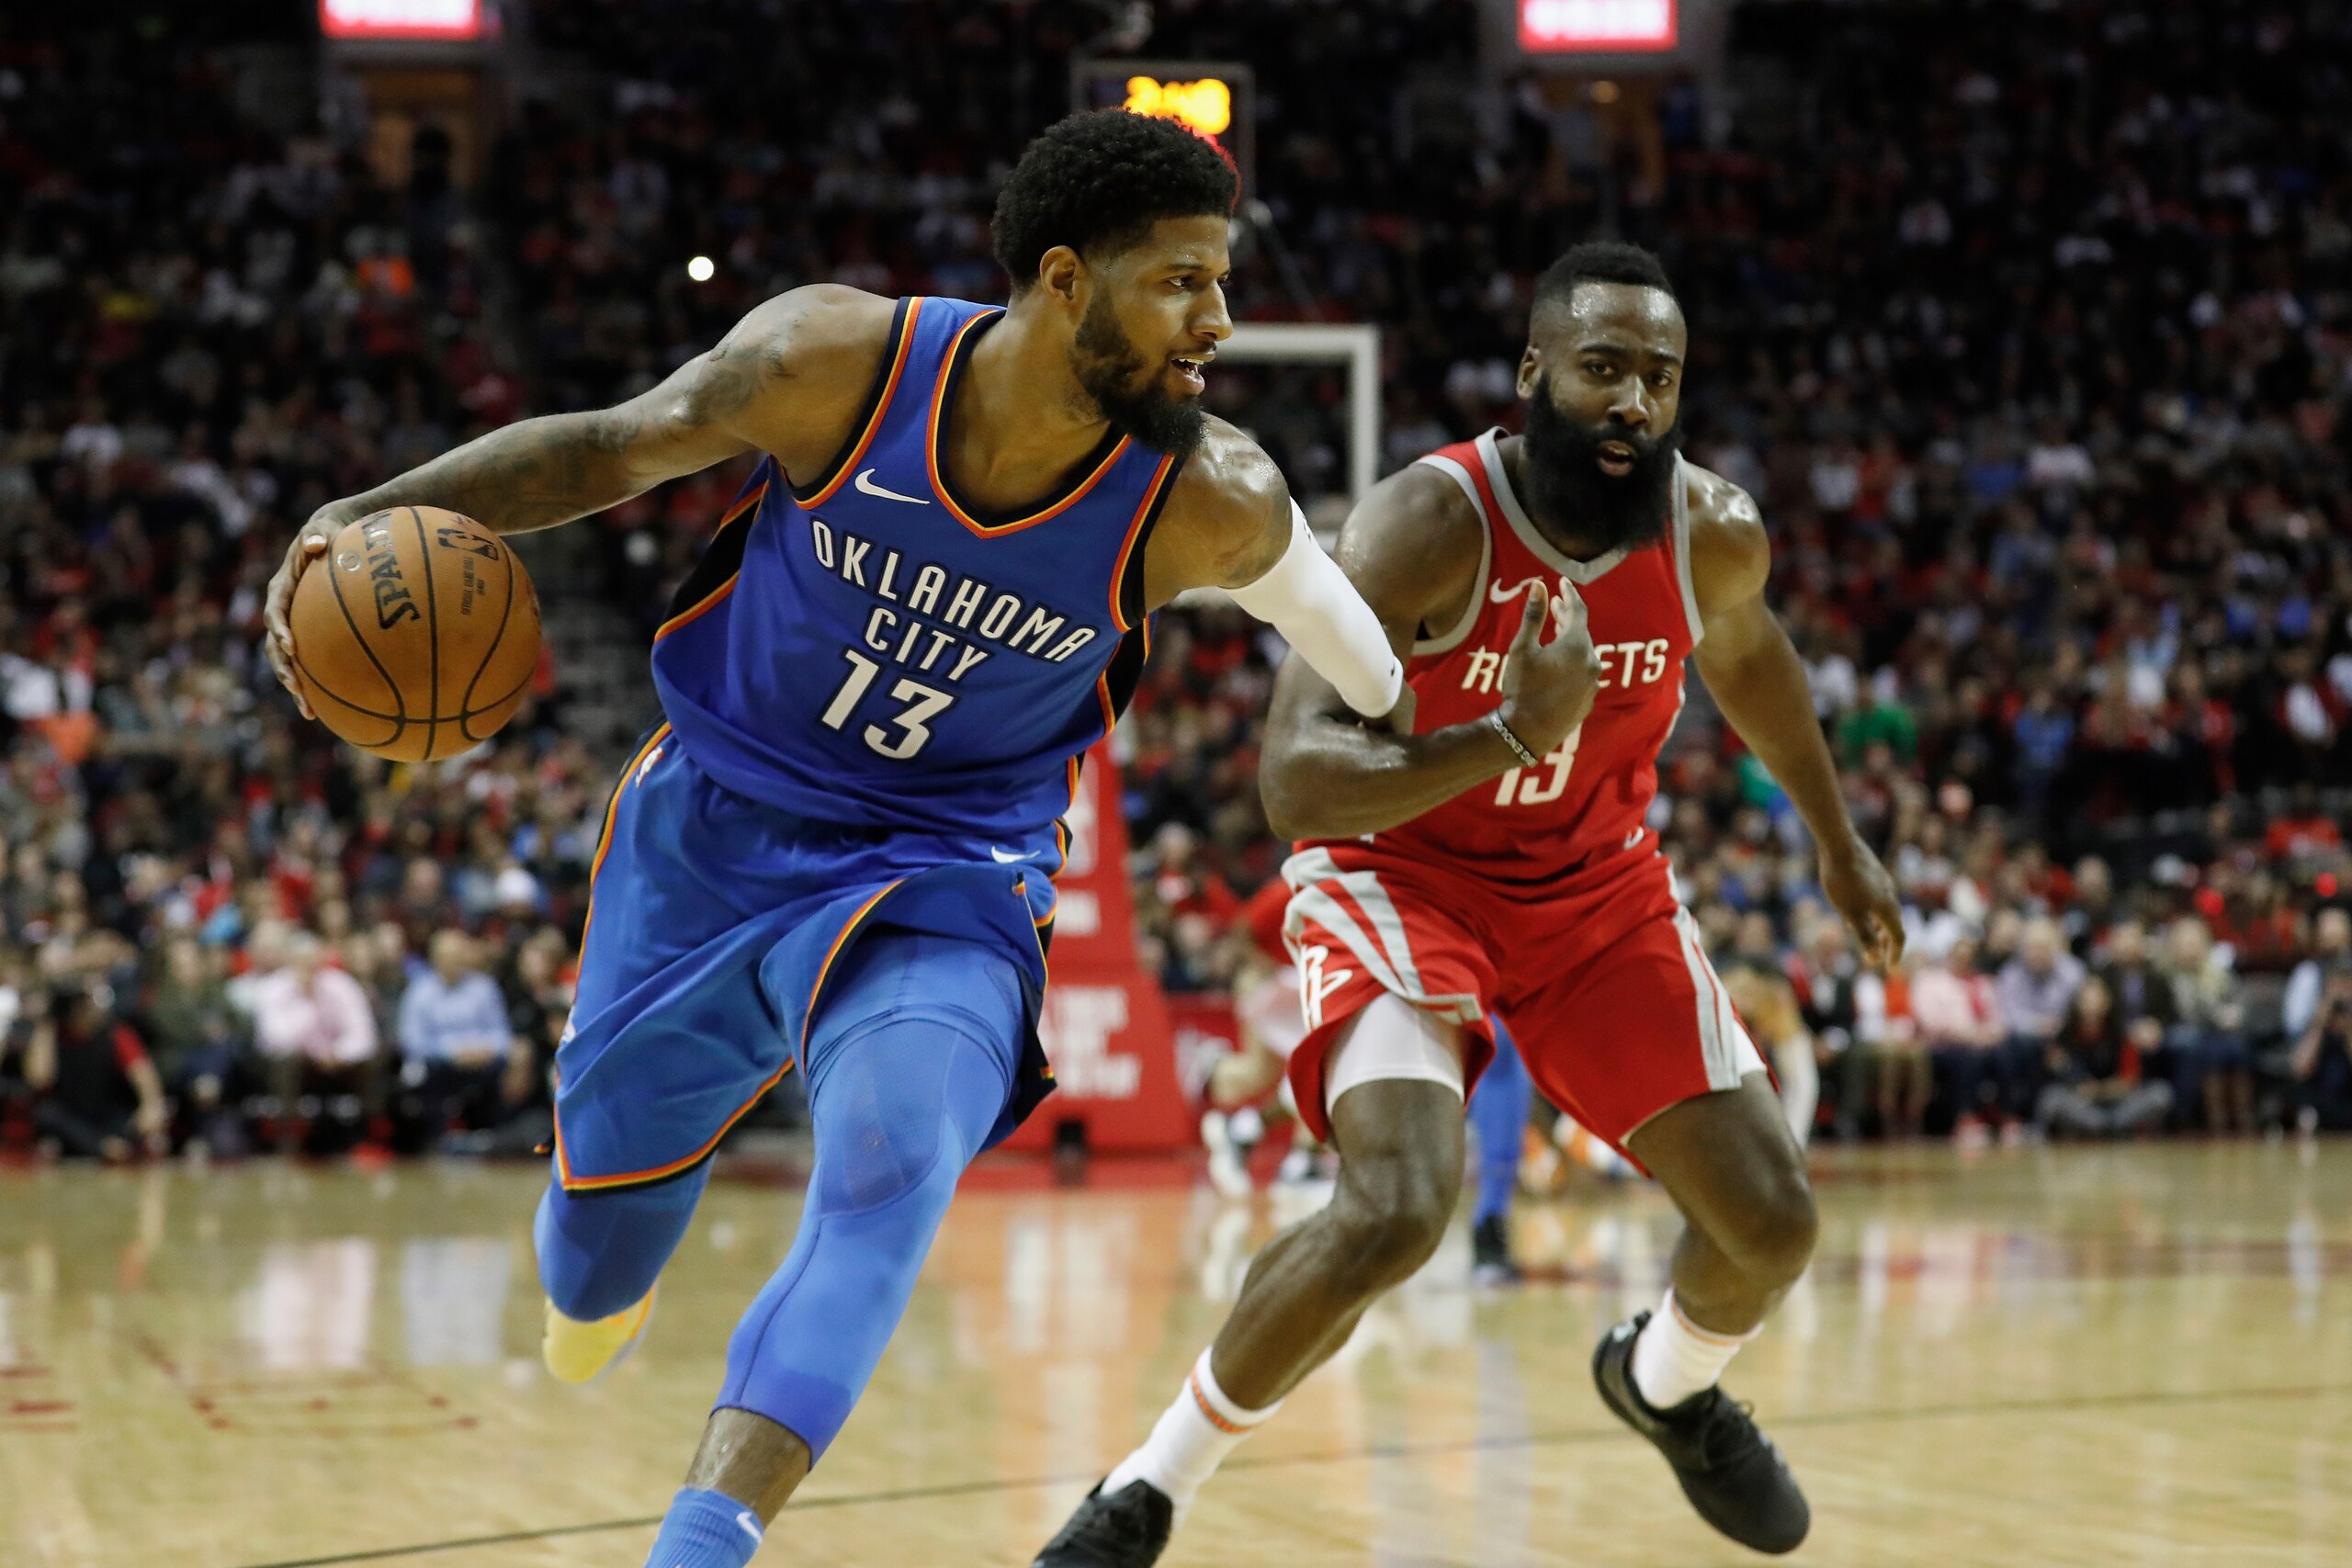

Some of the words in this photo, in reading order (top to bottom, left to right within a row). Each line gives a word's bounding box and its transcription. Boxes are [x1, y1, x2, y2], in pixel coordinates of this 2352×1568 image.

[362, 508, 421, 630] SPALD
[810, 518, 1101, 664] OKLAHOMA
[863, 606, 989, 682] CITY
[1461, 637, 1669, 694] RETS
[819, 648, 956, 761] 13
